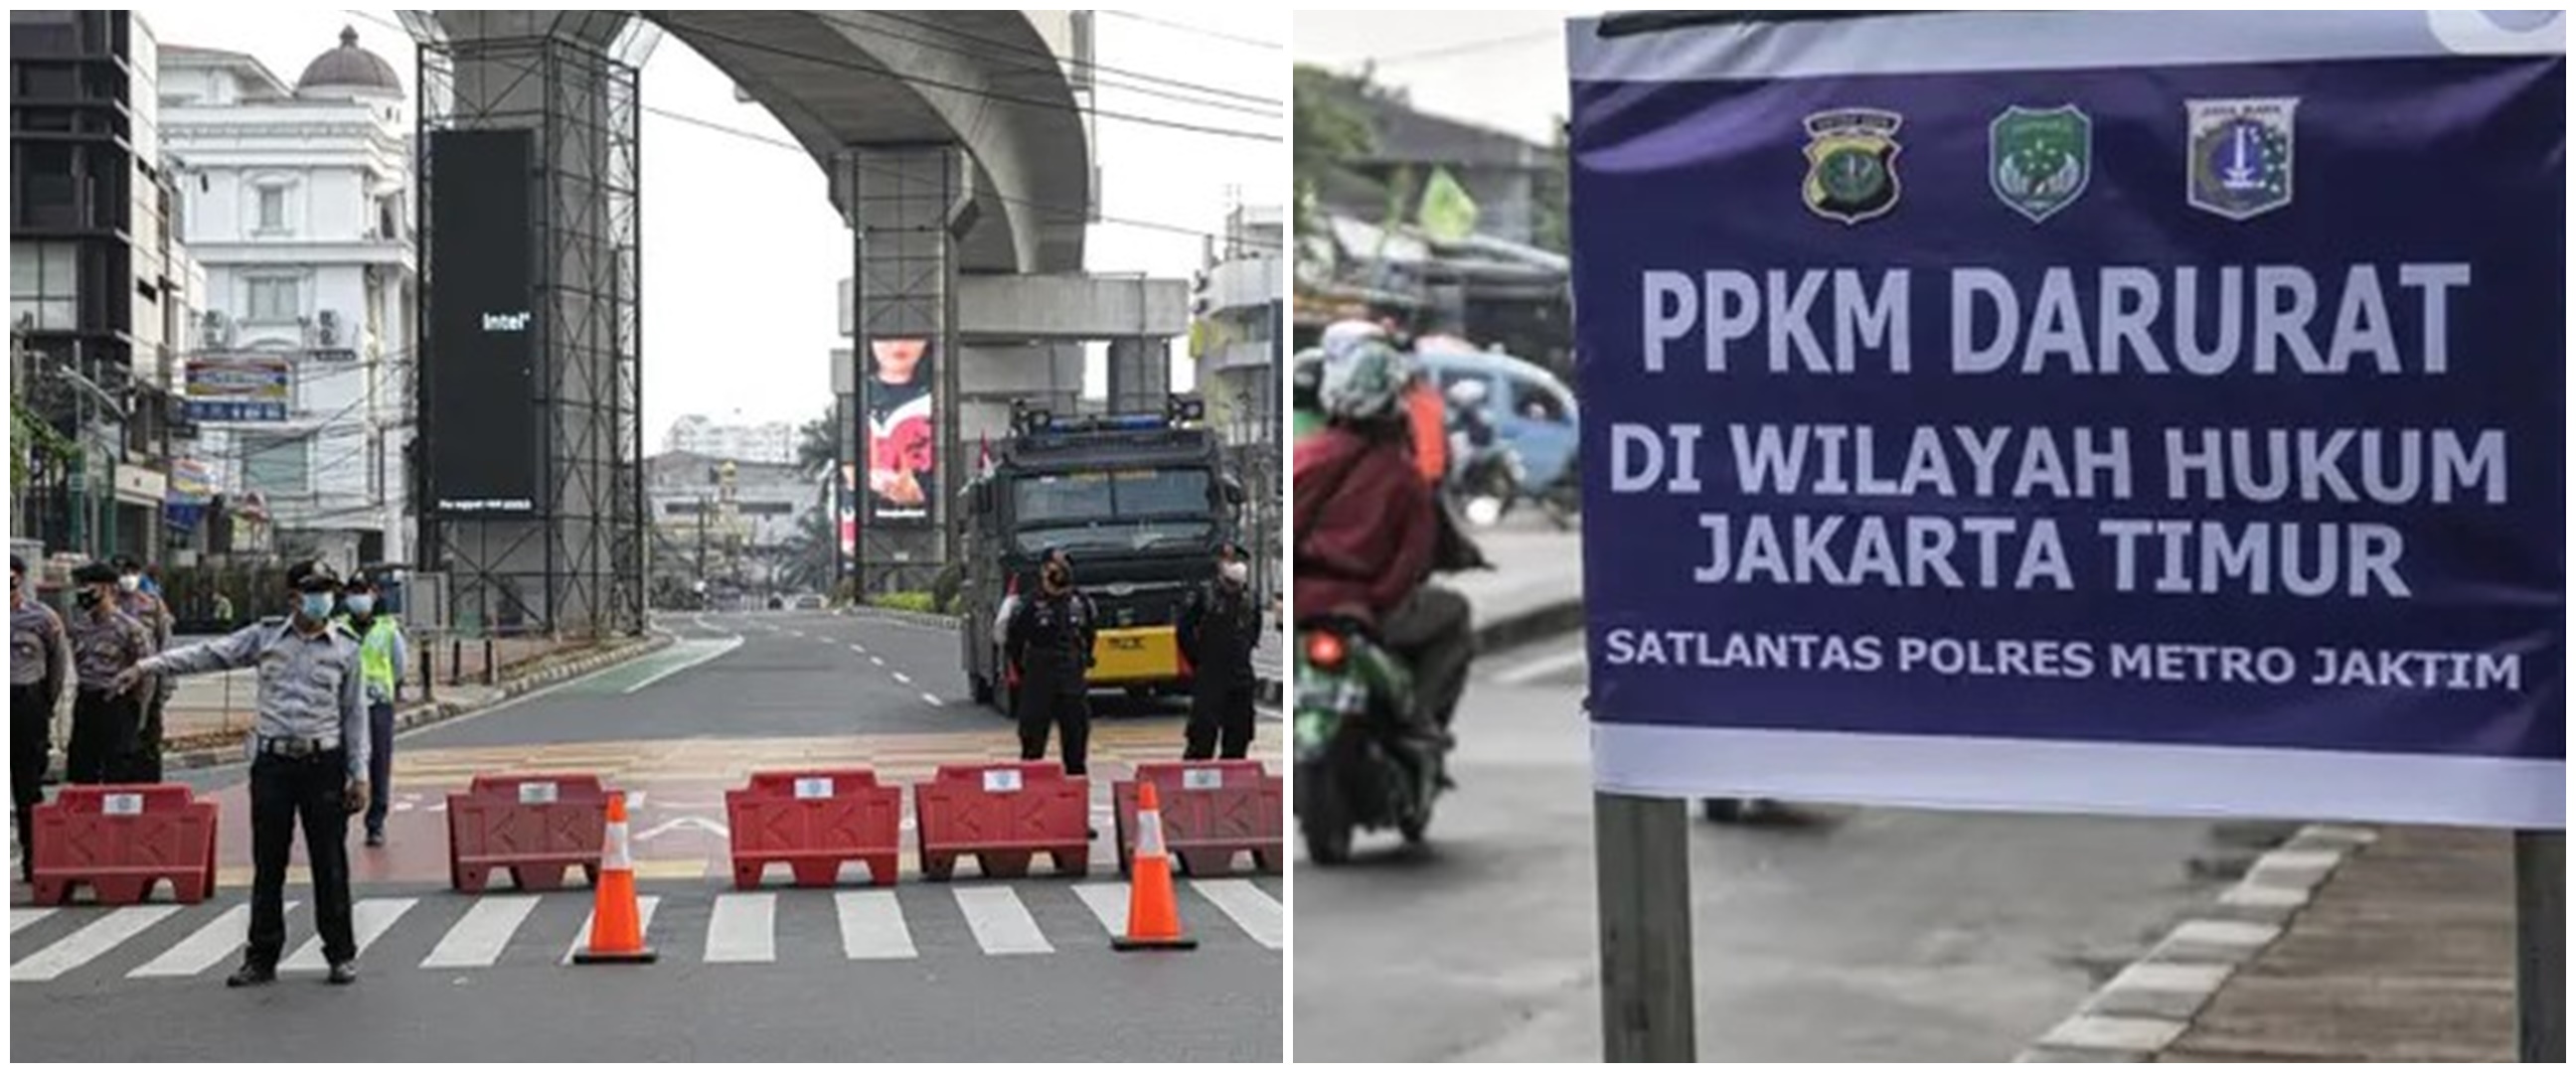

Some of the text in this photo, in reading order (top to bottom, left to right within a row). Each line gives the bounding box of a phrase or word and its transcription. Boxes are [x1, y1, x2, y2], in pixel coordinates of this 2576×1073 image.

[1644, 264, 2471, 375] PPKM DARURAT
[1611, 423, 2506, 504] DI WILAYAH HUKUM
[1693, 514, 2411, 597] JAKARTA TIMUR
[1607, 629, 2518, 690] SATLANTAS POLRES METRO JAKTIM
